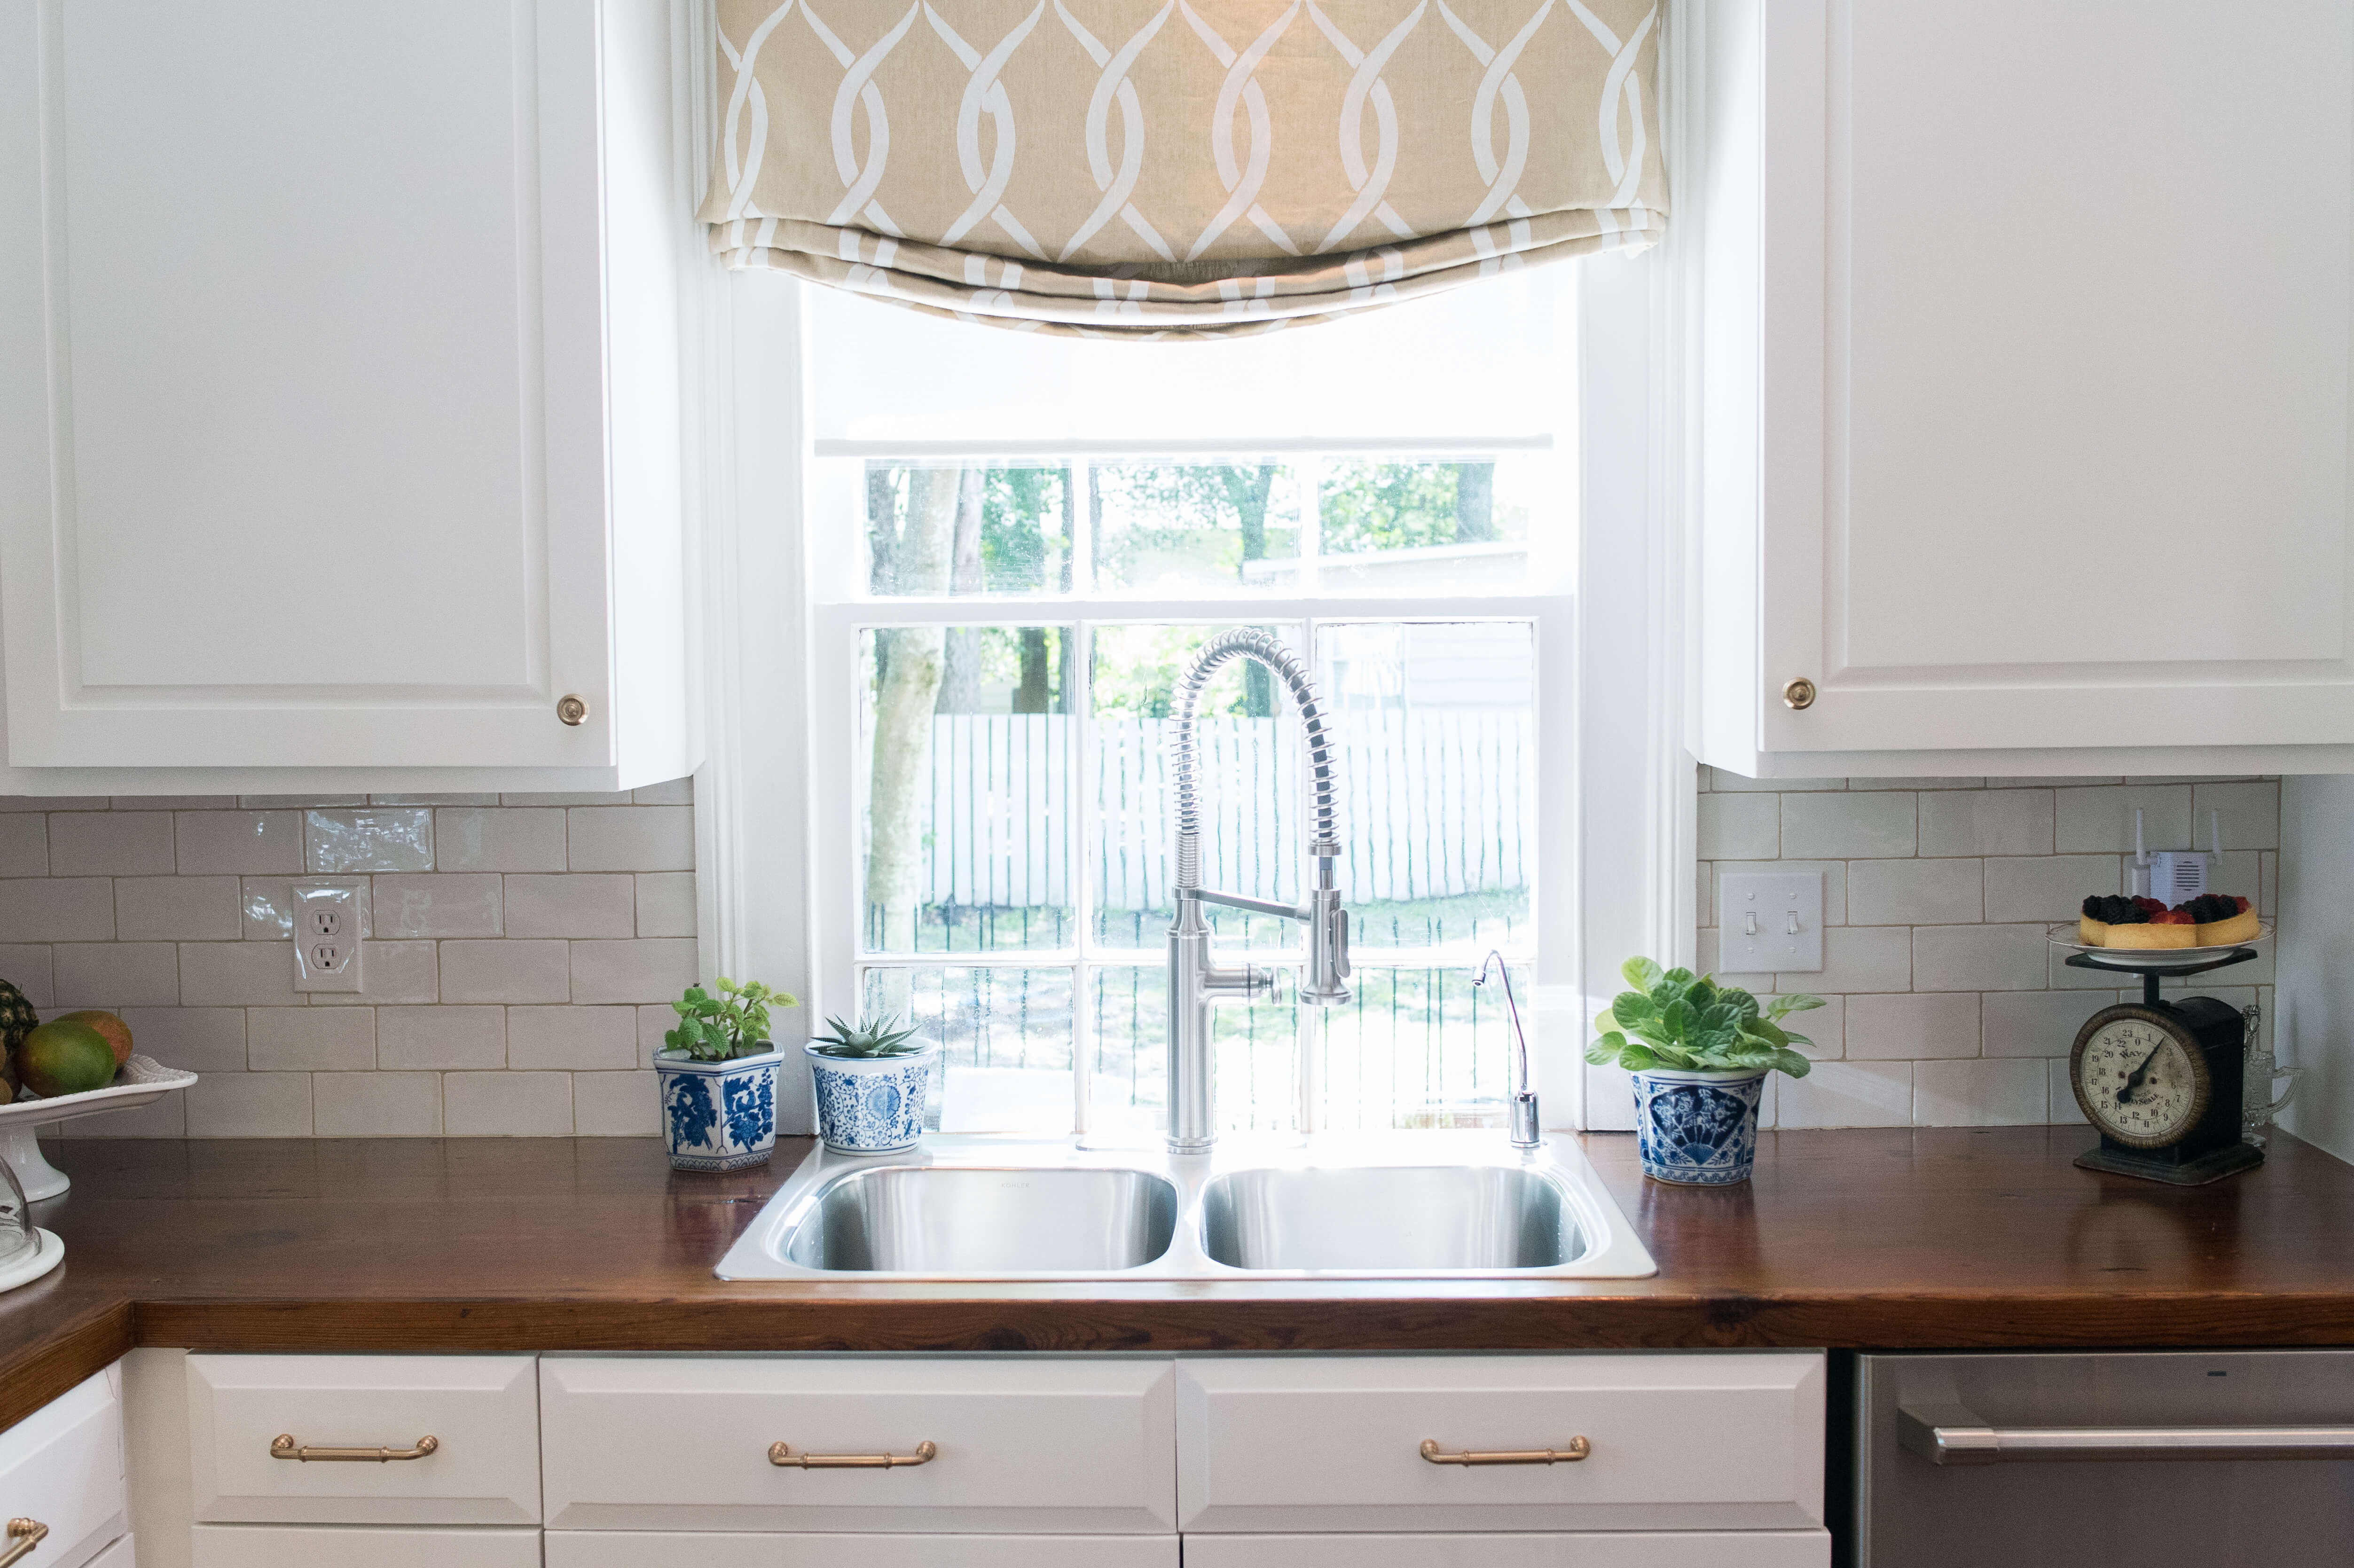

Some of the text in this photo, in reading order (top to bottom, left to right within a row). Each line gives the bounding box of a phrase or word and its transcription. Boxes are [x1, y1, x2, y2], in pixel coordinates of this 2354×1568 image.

[2103, 1037, 2110, 1046] 21
[2117, 1039, 2126, 1048] 22
[2101, 1100, 2108, 1109] 15
[2115, 1102, 2121, 1110] 14
[2150, 1108, 2158, 1117] 10
[2163, 1113, 2168, 1121] 9
